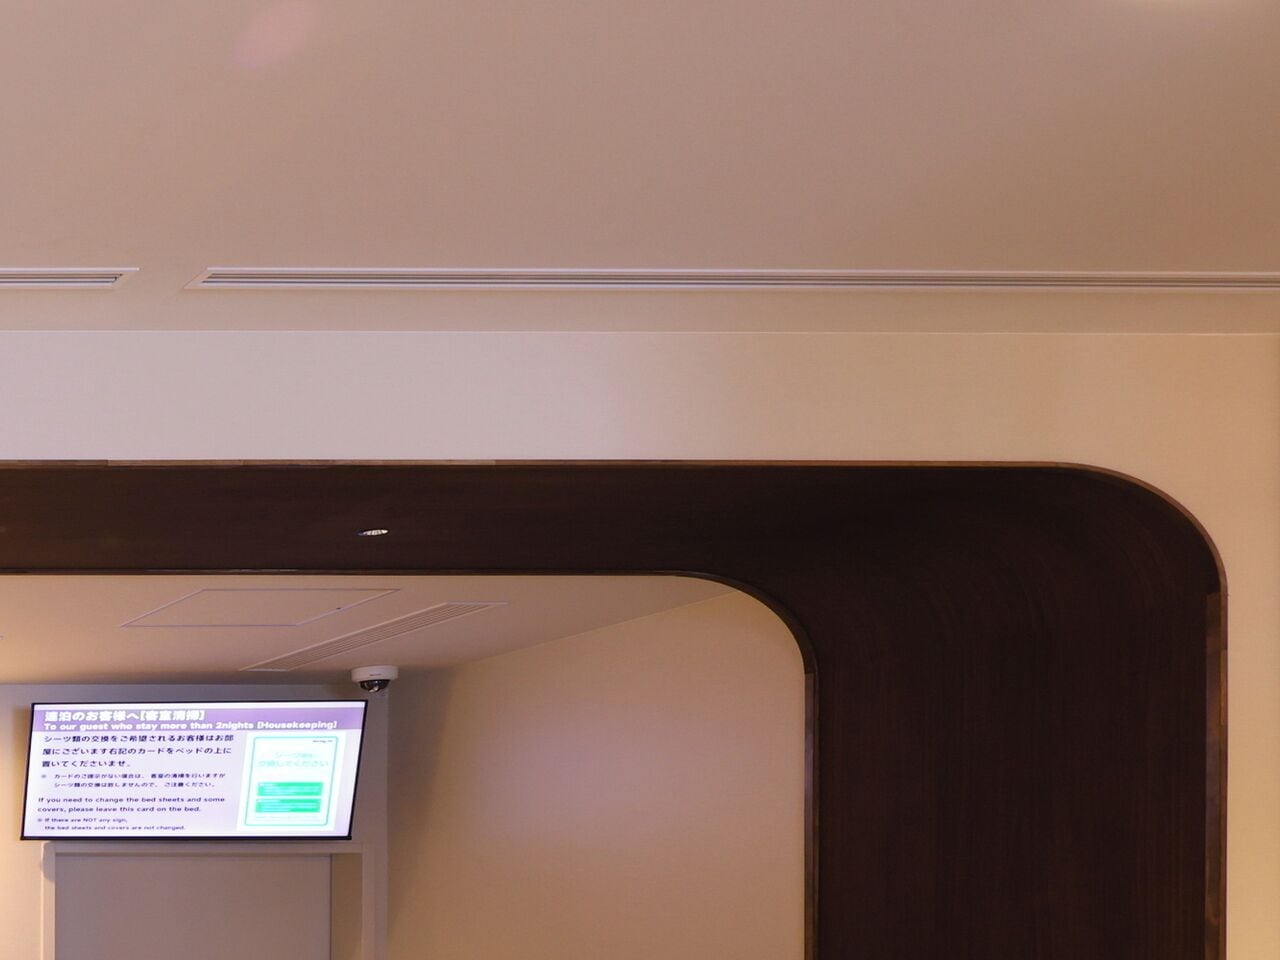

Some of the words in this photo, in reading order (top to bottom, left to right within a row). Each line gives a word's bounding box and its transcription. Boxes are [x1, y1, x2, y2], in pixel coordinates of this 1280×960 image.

[80, 723, 108, 731] guest
[135, 723, 157, 731] stay
[190, 722, 213, 730] than
[215, 722, 254, 731] 2nights
